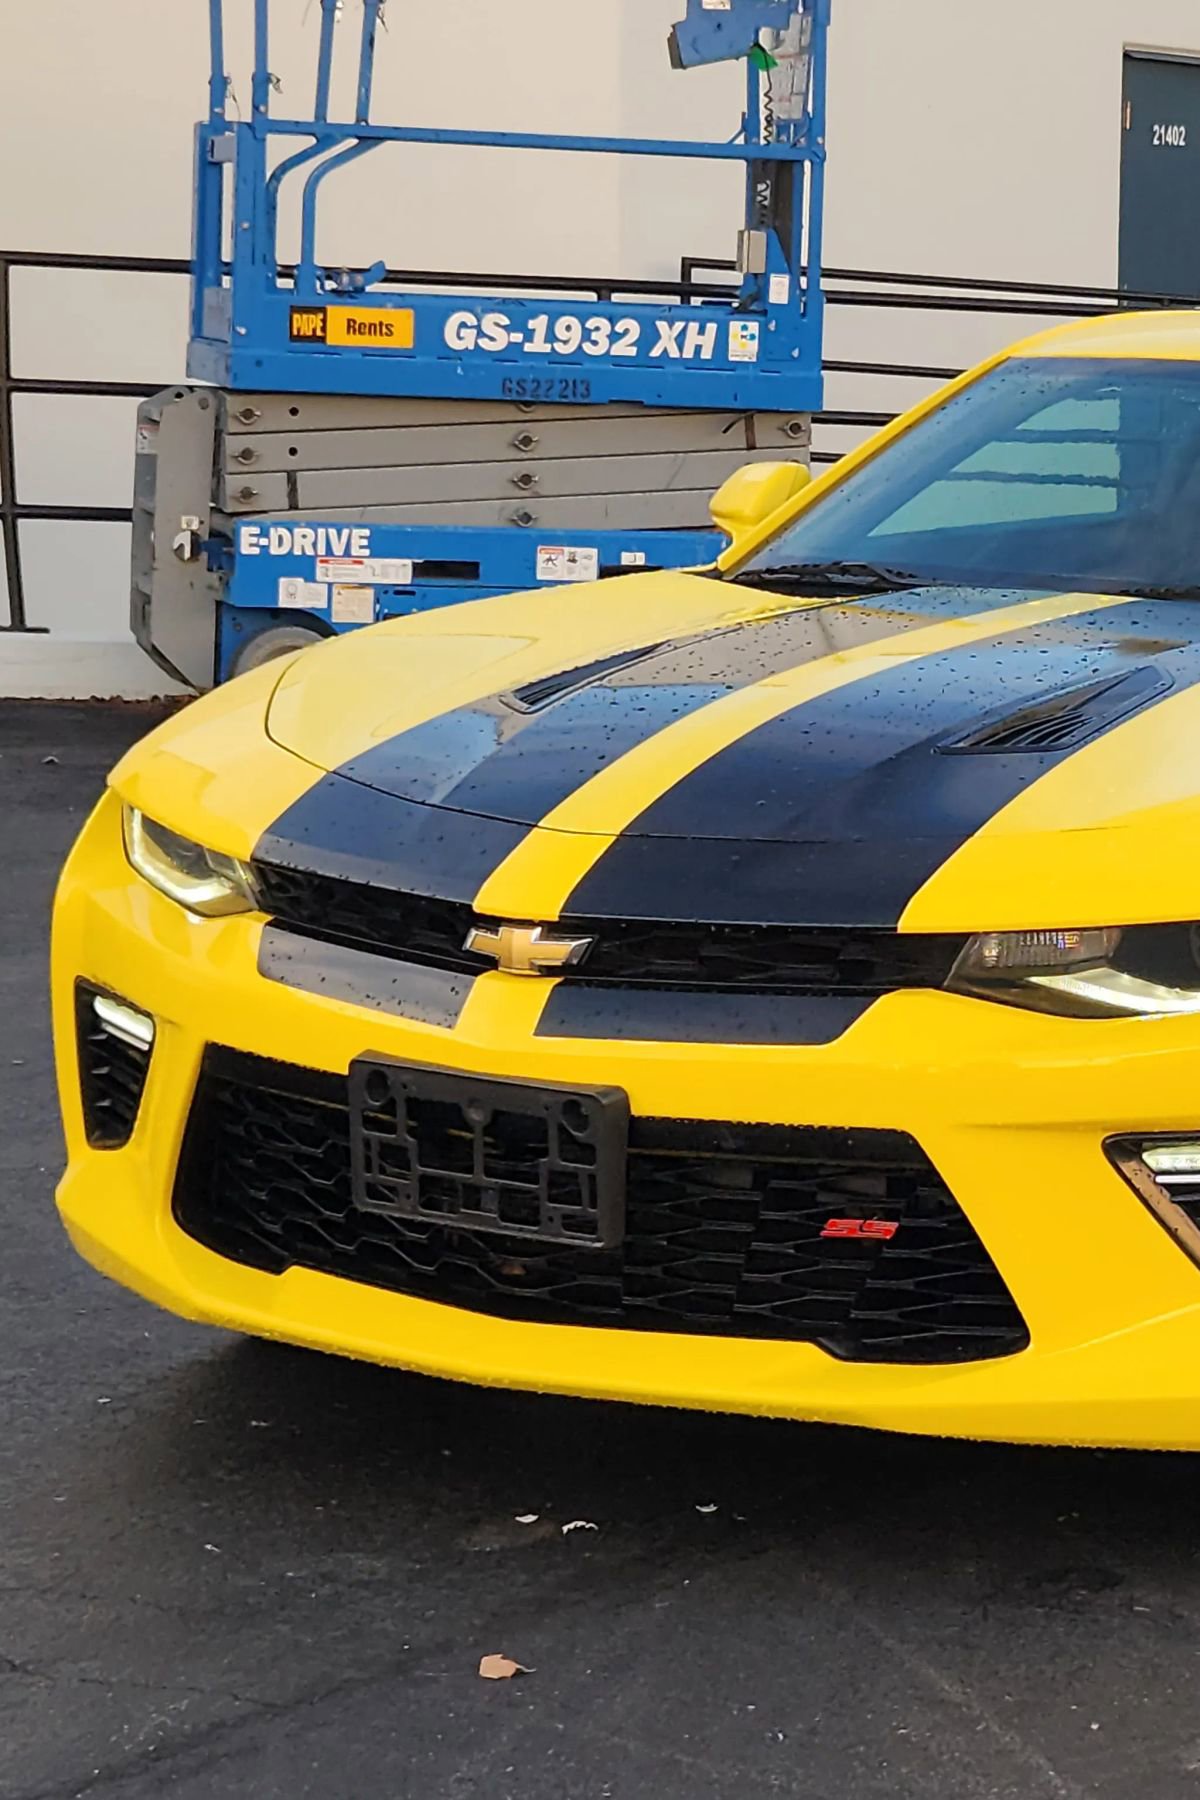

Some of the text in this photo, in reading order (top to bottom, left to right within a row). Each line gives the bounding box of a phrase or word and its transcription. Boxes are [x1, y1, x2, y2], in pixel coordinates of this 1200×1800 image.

[1152, 124, 1186, 146] 21402
[346, 317, 395, 337] Rents
[443, 310, 718, 360] GS-1932 XH
[240, 525, 371, 557] E-DRIVE
[819, 1218, 900, 1240] SS
